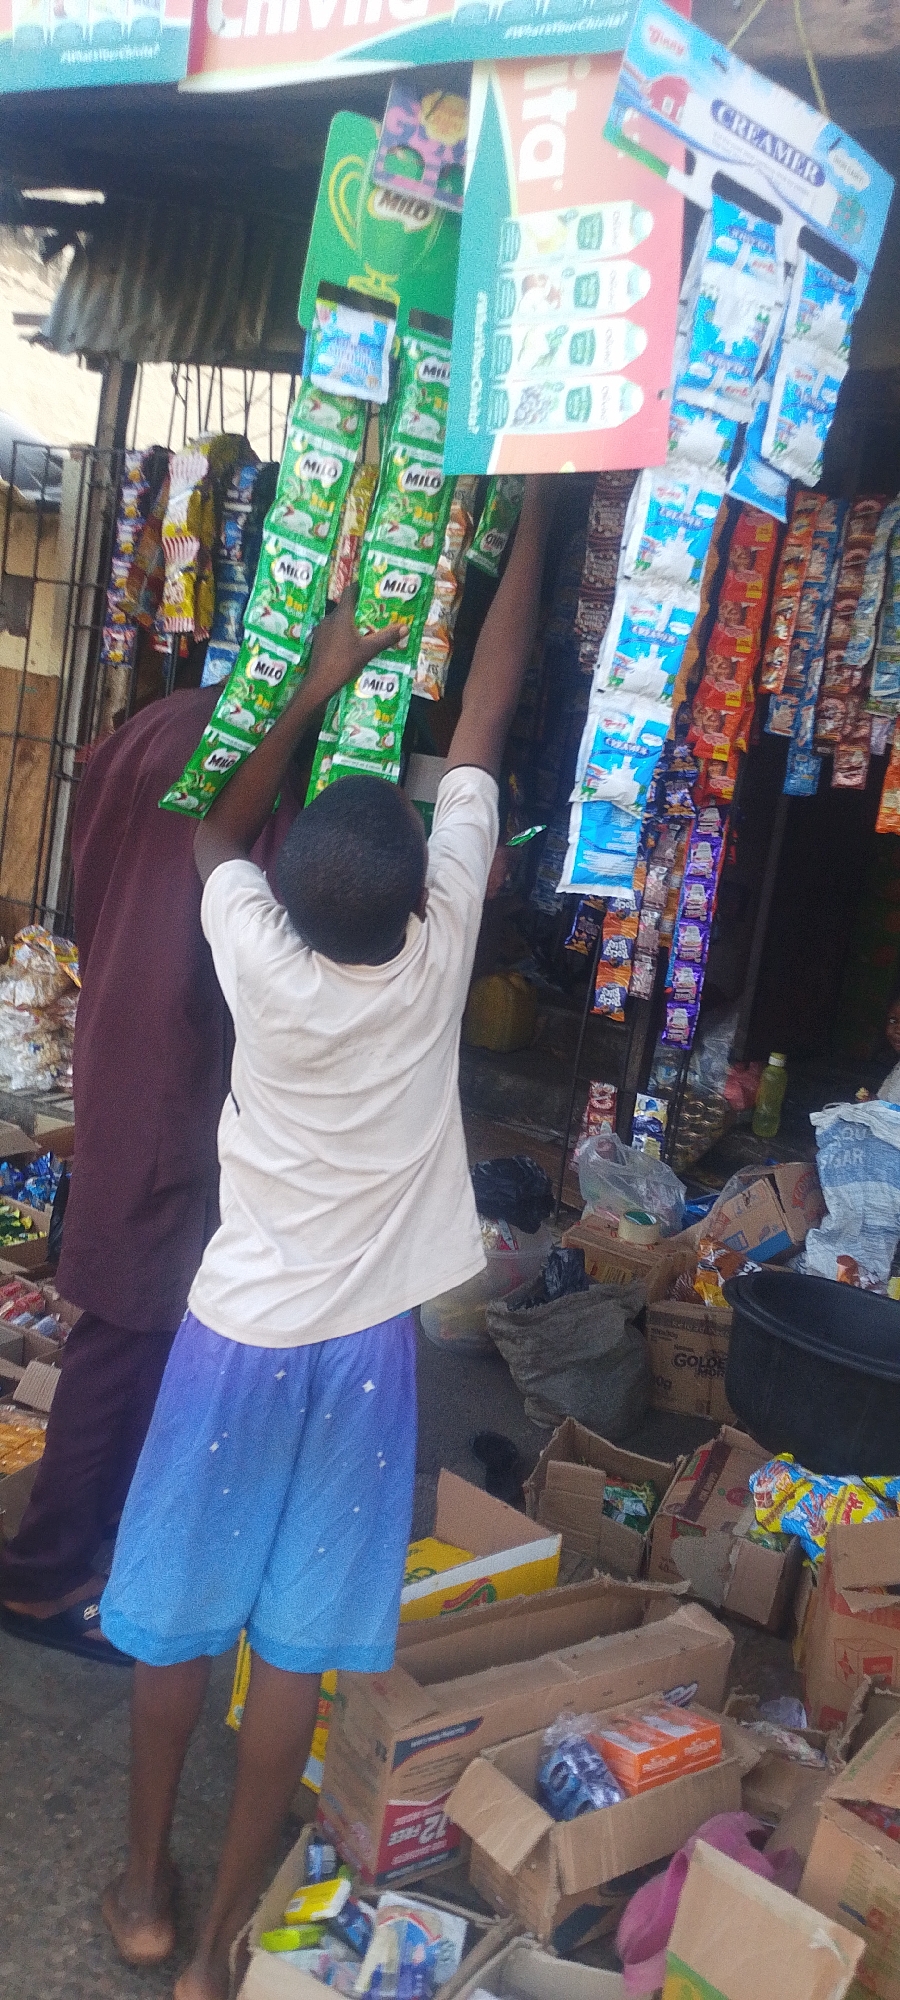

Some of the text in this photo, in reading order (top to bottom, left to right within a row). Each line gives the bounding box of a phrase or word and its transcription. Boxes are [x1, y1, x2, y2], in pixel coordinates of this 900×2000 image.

[716, 103, 819, 183] CREAMER
[422, 363, 450, 380] MIL
[303, 458, 339, 479] MILO
[405, 472, 442, 488] MILO
[278, 561, 310, 581] MILO
[382, 578, 418, 595] MILO
[254, 661, 284, 680] MILO
[362, 678, 395, 694] MILO
[208, 753, 236, 770] MILO
[673, 1352, 728, 1370] GOLDE
[697, 1367, 726, 1378] MOR
